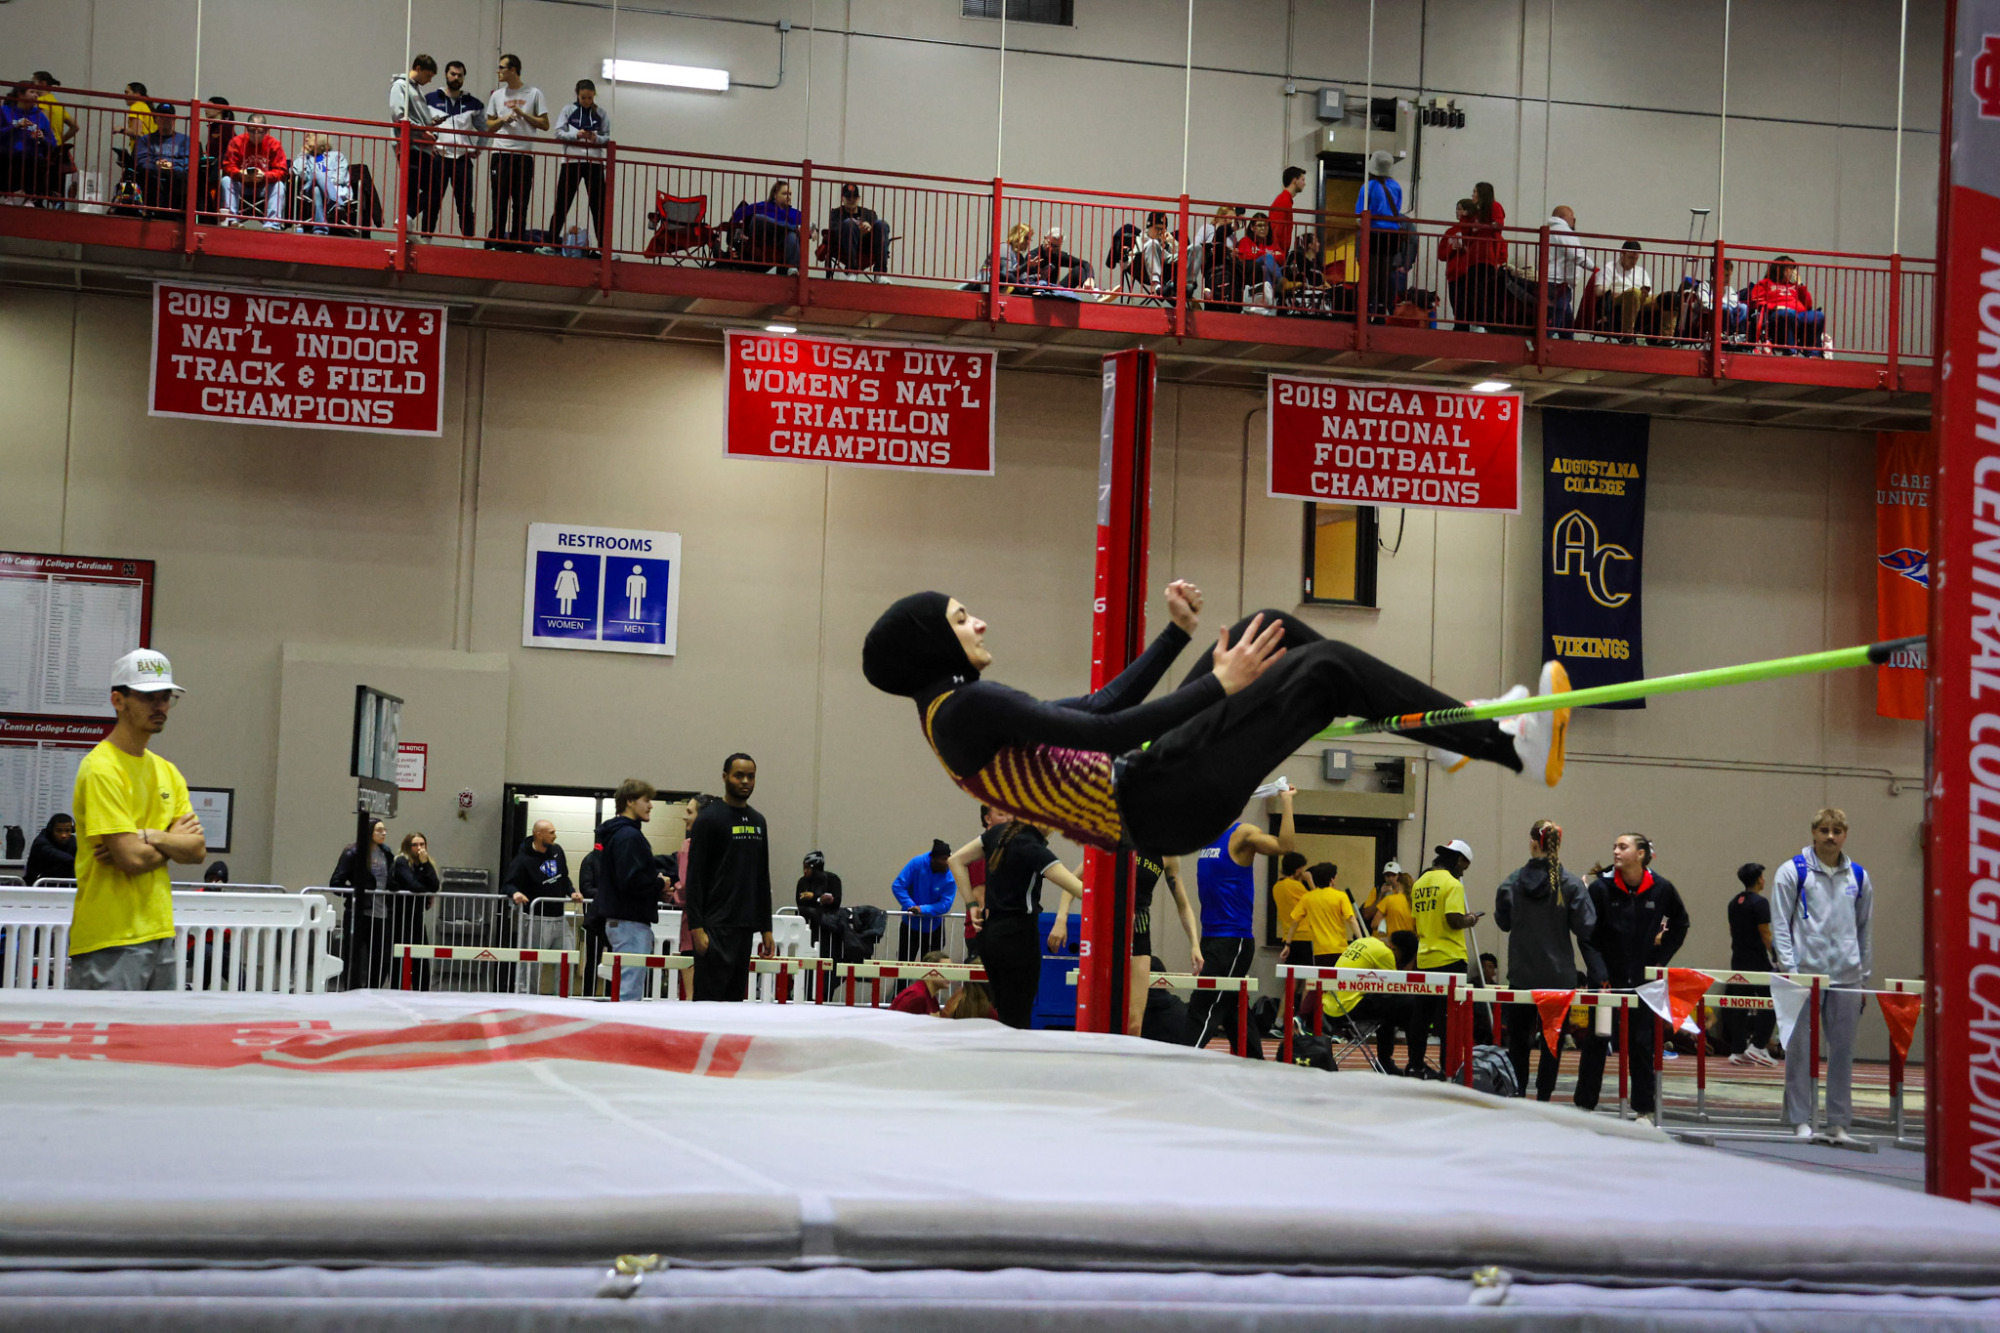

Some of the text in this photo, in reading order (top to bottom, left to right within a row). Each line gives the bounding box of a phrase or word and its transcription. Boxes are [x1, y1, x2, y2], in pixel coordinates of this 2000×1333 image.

[168, 292, 434, 335] 2019 NCAA DIV. 3
[182, 323, 418, 364] NAT'L INDOOR
[740, 339, 982, 378] 2019 USAT DIV. 3
[171, 354, 426, 395] TRACK & FIELD
[743, 368, 980, 408] WOMEN'S NAT'L
[1103, 372, 1115, 389] 8
[201, 387, 394, 425] CHAMPIONS
[1279, 383, 1511, 421] 2019 NCAA DIV. 3
[771, 401, 949, 436] TRIATHLON
[1322, 416, 1470, 448] NATIONAL
[769, 430, 950, 465] CHAMPIONS
[1314, 443, 1476, 477] FOOTBALL
[1551, 457, 1640, 478] AUGUSTANA
[1099, 484, 1111, 501] 7
[1310, 472, 1480, 504] CHAMPIONS
[1564, 477, 1625, 495] COLLEGE
[558, 533, 652, 552] RESTROOMS
[15, 557, 44, 566] Central
[45, 559, 75, 569] College
[76, 561, 113, 571] Cardinals
[1970, 455, 2000, 700] CENTRAL
[1093, 598, 1107, 613] 6
[547, 620, 584, 630] WOMEN
[624, 625, 645, 634] MEN
[1552, 635, 1629, 659] VIKINGS
[4, 722, 33, 732] Central
[35, 723, 65, 734] College
[66, 725, 103, 734] Cardinals
[1968, 713, 2000, 952] COLLEGE
[1143, 858, 1162, 877] PARK
[1080, 940, 1091, 956] 3
[1350, 981, 1432, 994] NORTH CENTRAL
[1731, 998, 1764, 1008] NORTH
[1968, 964, 2000, 1207] CARDINA
